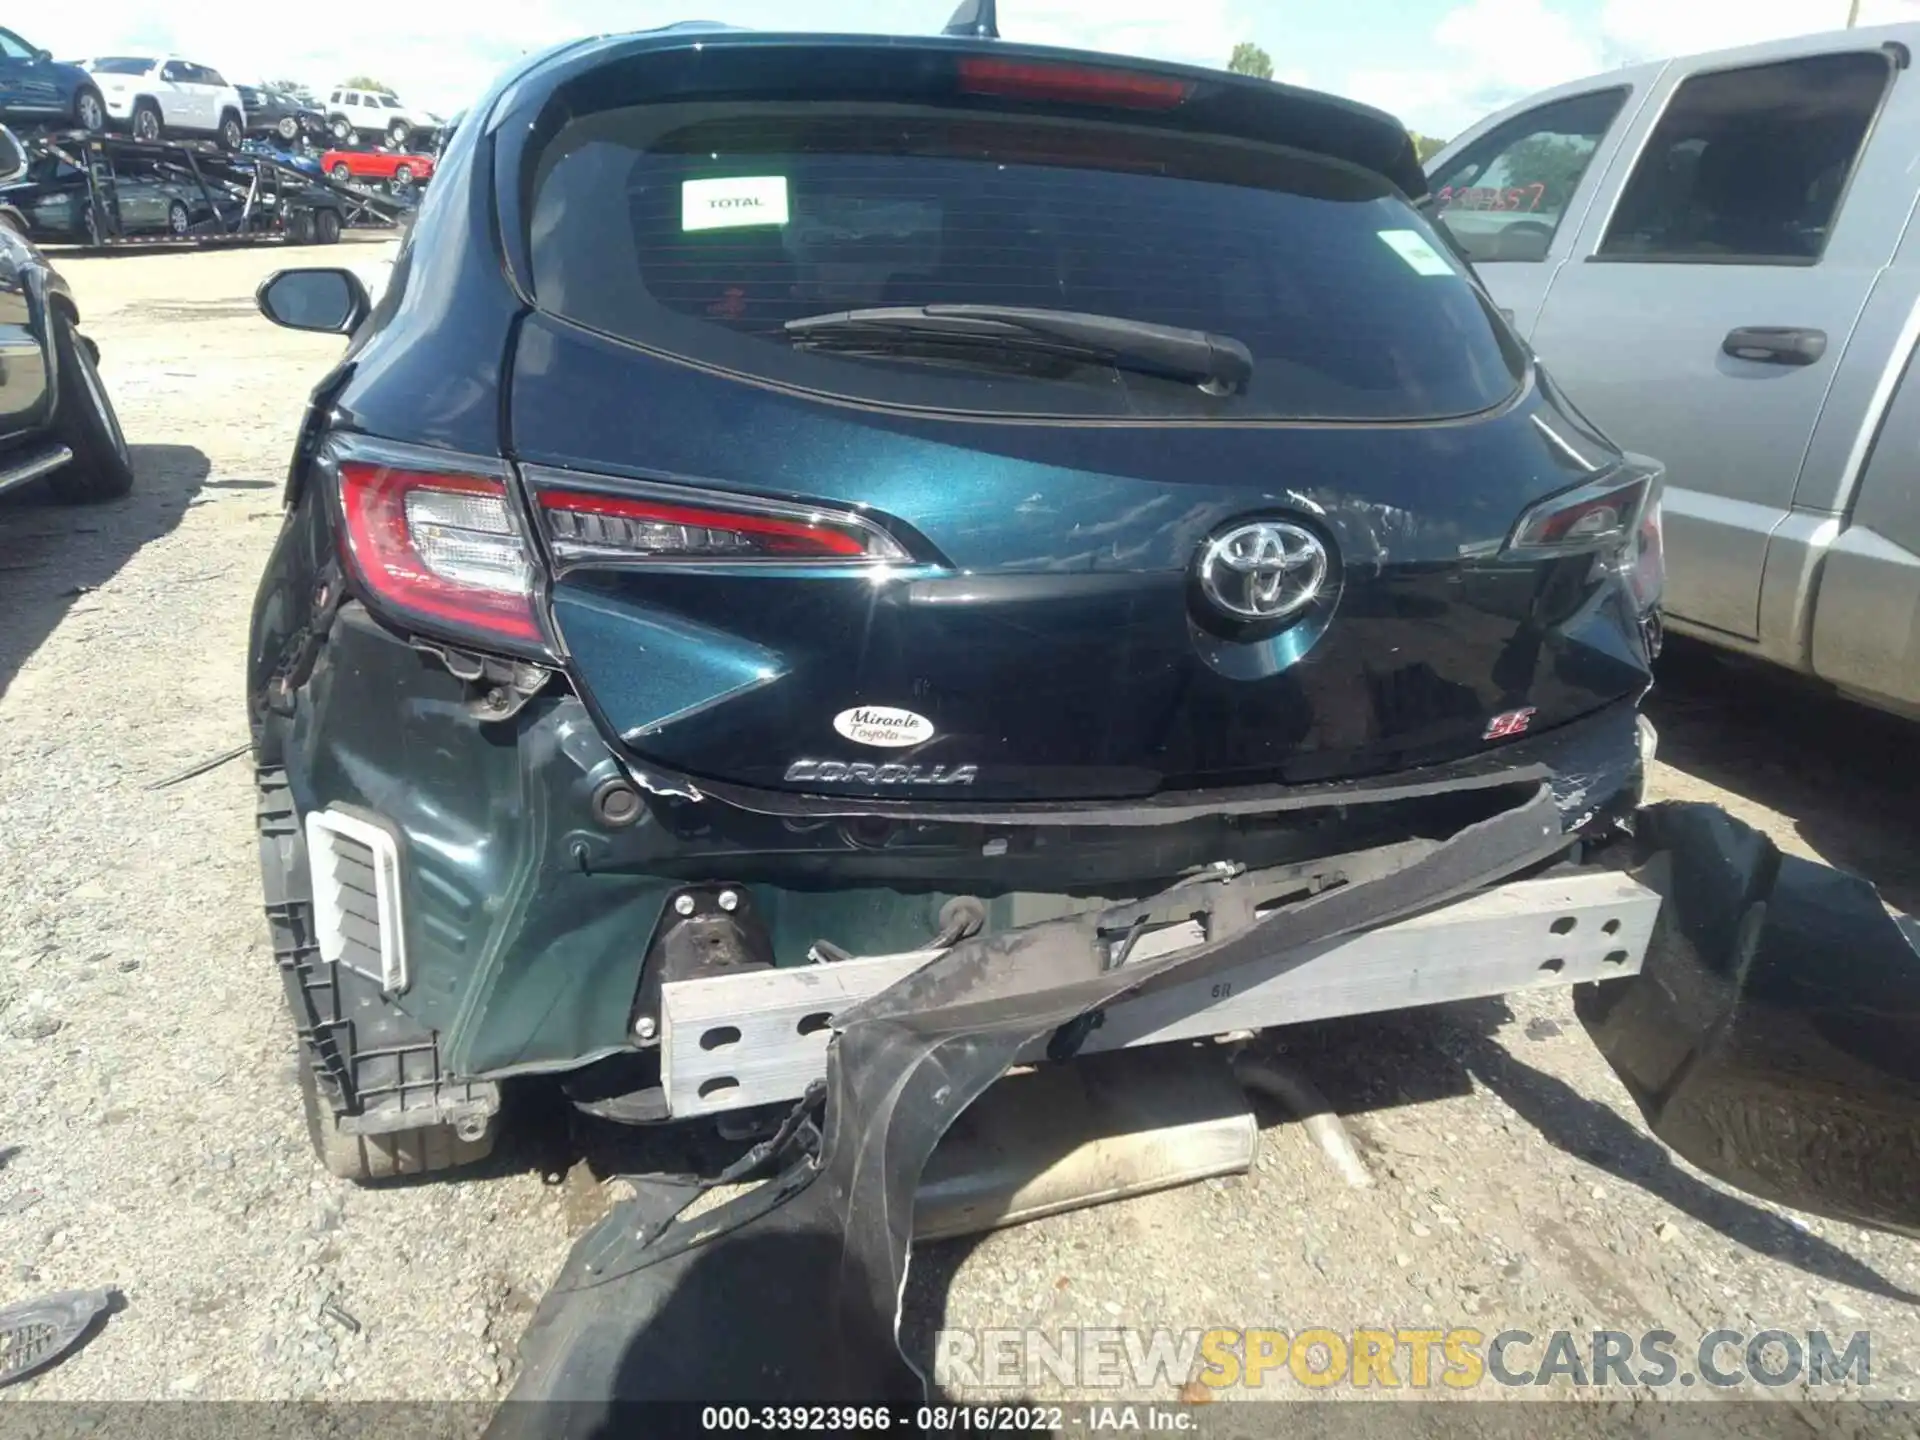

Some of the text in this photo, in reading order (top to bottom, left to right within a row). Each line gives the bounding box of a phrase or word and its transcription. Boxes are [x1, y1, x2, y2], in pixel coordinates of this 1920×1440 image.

[707, 196, 766, 209] TOTAL
[850, 708, 921, 729] Miracle
[849, 723, 899, 743] Toyota
[784, 759, 978, 785] COROLLA
